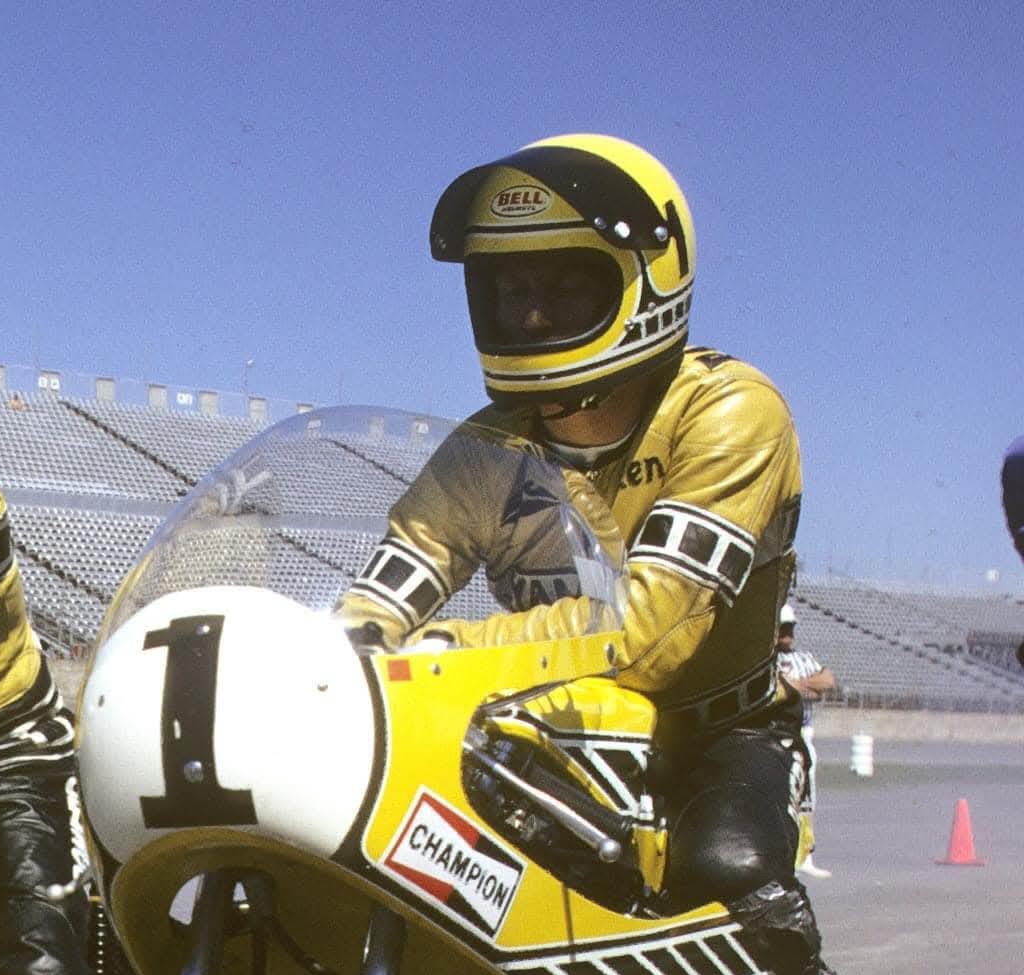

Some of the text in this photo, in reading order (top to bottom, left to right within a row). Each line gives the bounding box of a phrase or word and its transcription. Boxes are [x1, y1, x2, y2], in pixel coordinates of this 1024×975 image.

[496, 191, 544, 207] BELL
[139, 614, 259, 829] 1
[408, 823, 510, 910] CHAMPION
